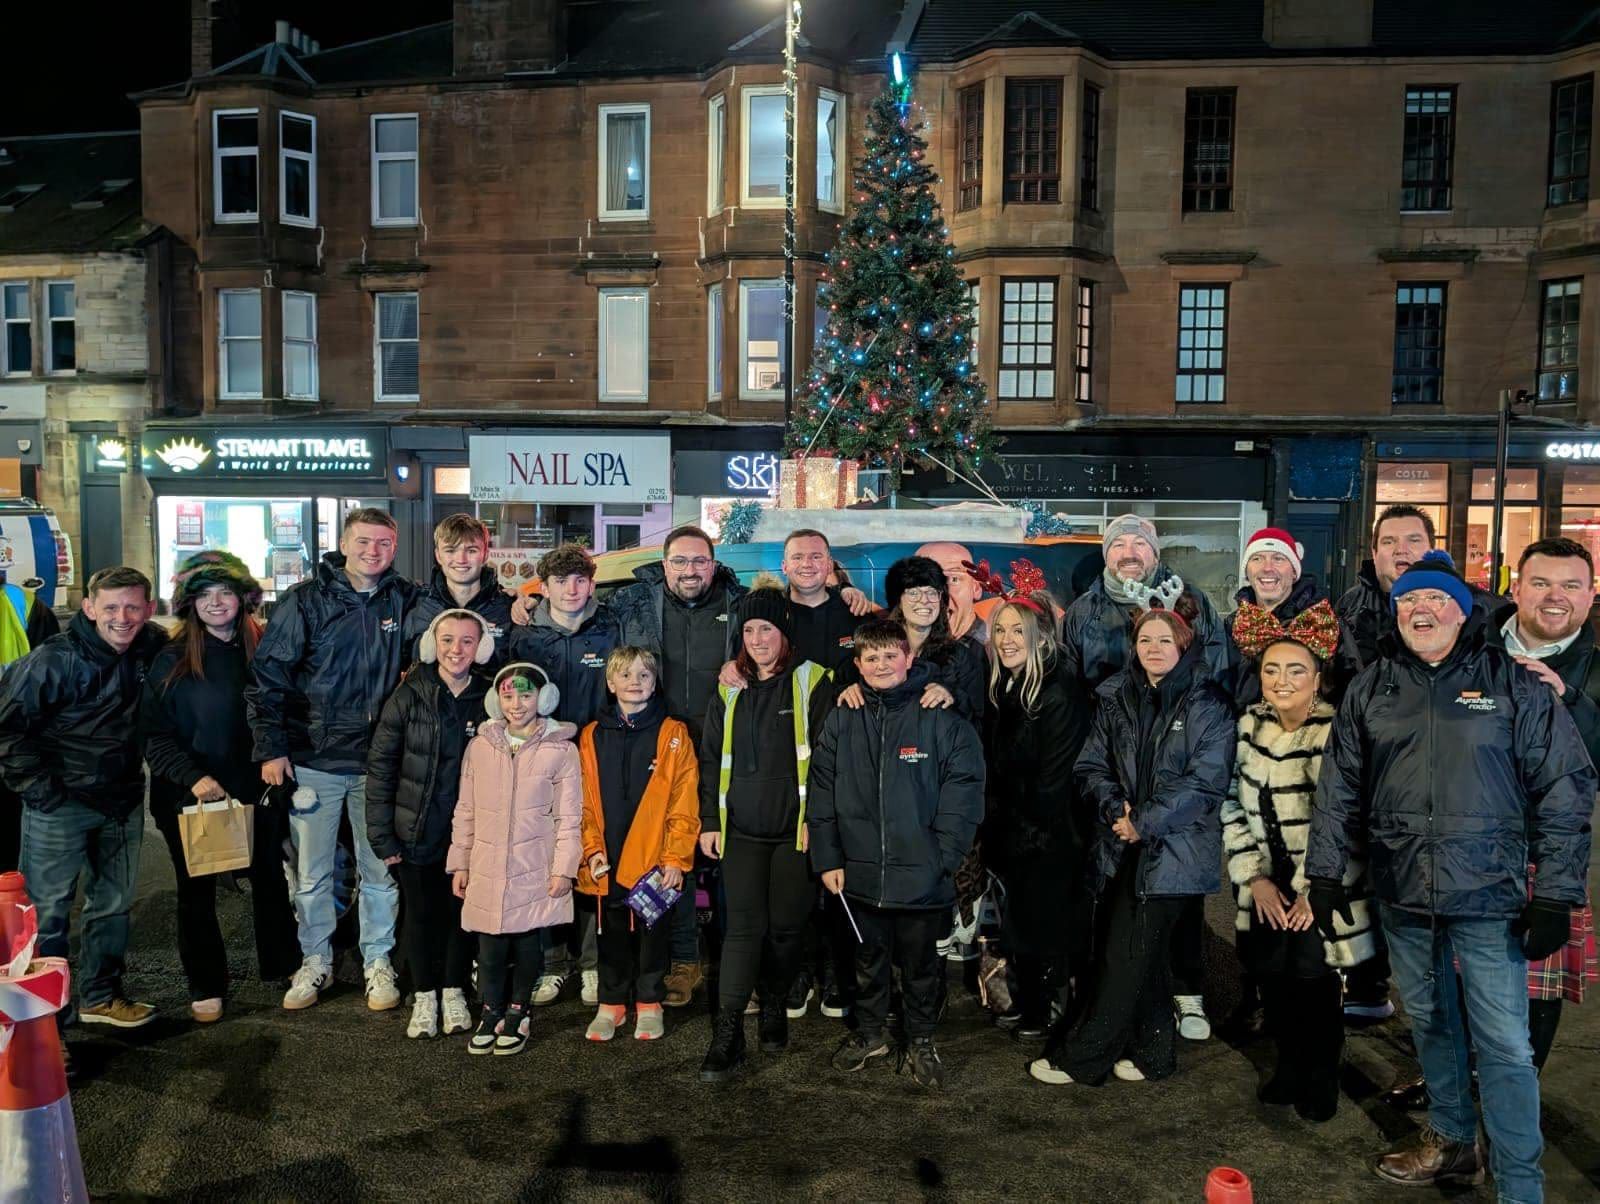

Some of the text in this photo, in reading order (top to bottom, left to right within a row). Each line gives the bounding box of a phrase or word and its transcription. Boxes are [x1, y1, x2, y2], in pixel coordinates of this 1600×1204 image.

[216, 438, 371, 458] STEWART TRAVEL
[1545, 442, 1600, 460] COSTA
[218, 461, 371, 471] A World of Experience
[507, 452, 632, 487] NAIL SPA
[1395, 470, 1430, 479] COSTA
